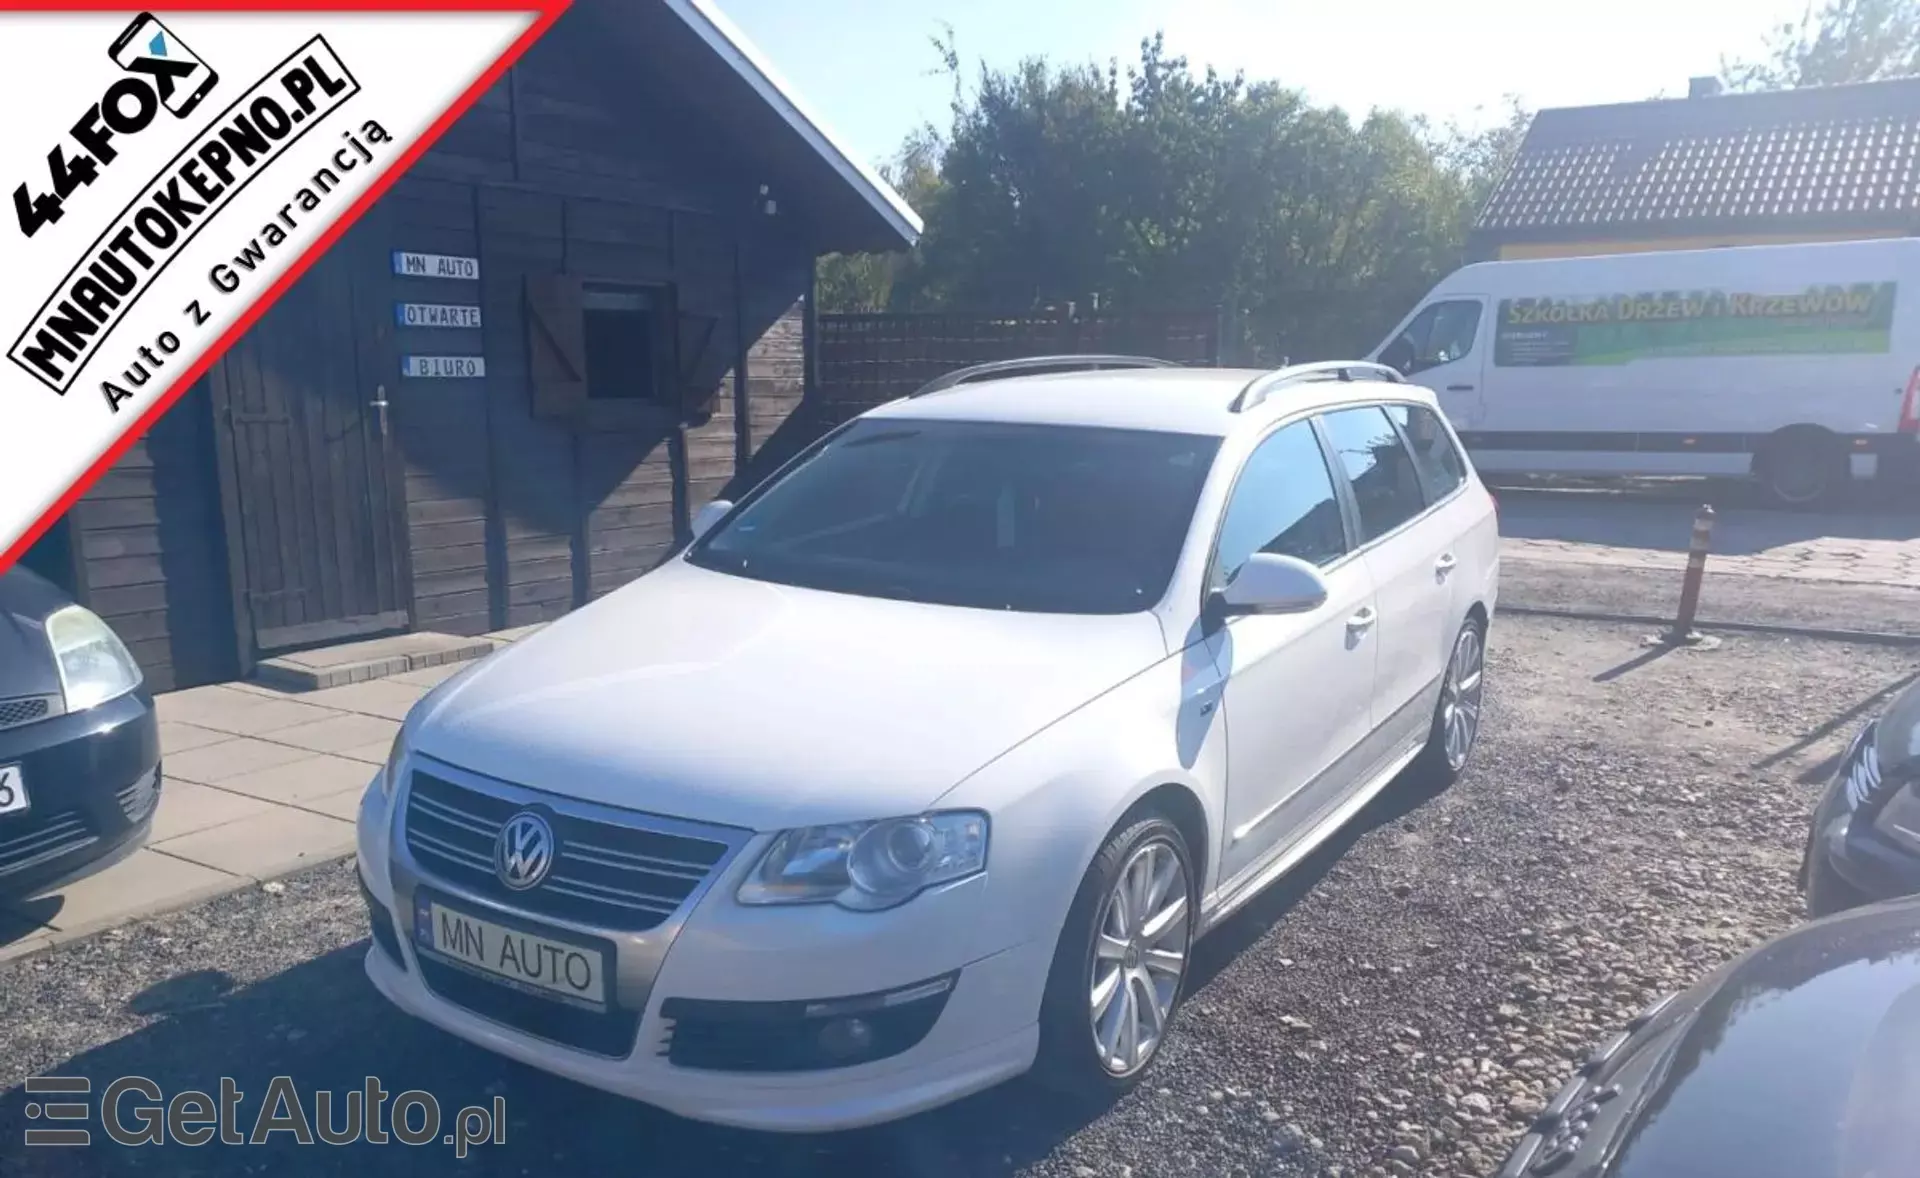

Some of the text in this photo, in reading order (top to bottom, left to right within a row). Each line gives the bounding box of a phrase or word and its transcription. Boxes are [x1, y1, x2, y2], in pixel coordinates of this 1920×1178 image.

[406, 255, 473, 277] MN AUTO
[407, 306, 480, 326] OTWARTE
[419, 359, 476, 377] BIURO
[441, 912, 485, 962] MN
[499, 934, 592, 991] AUTO
